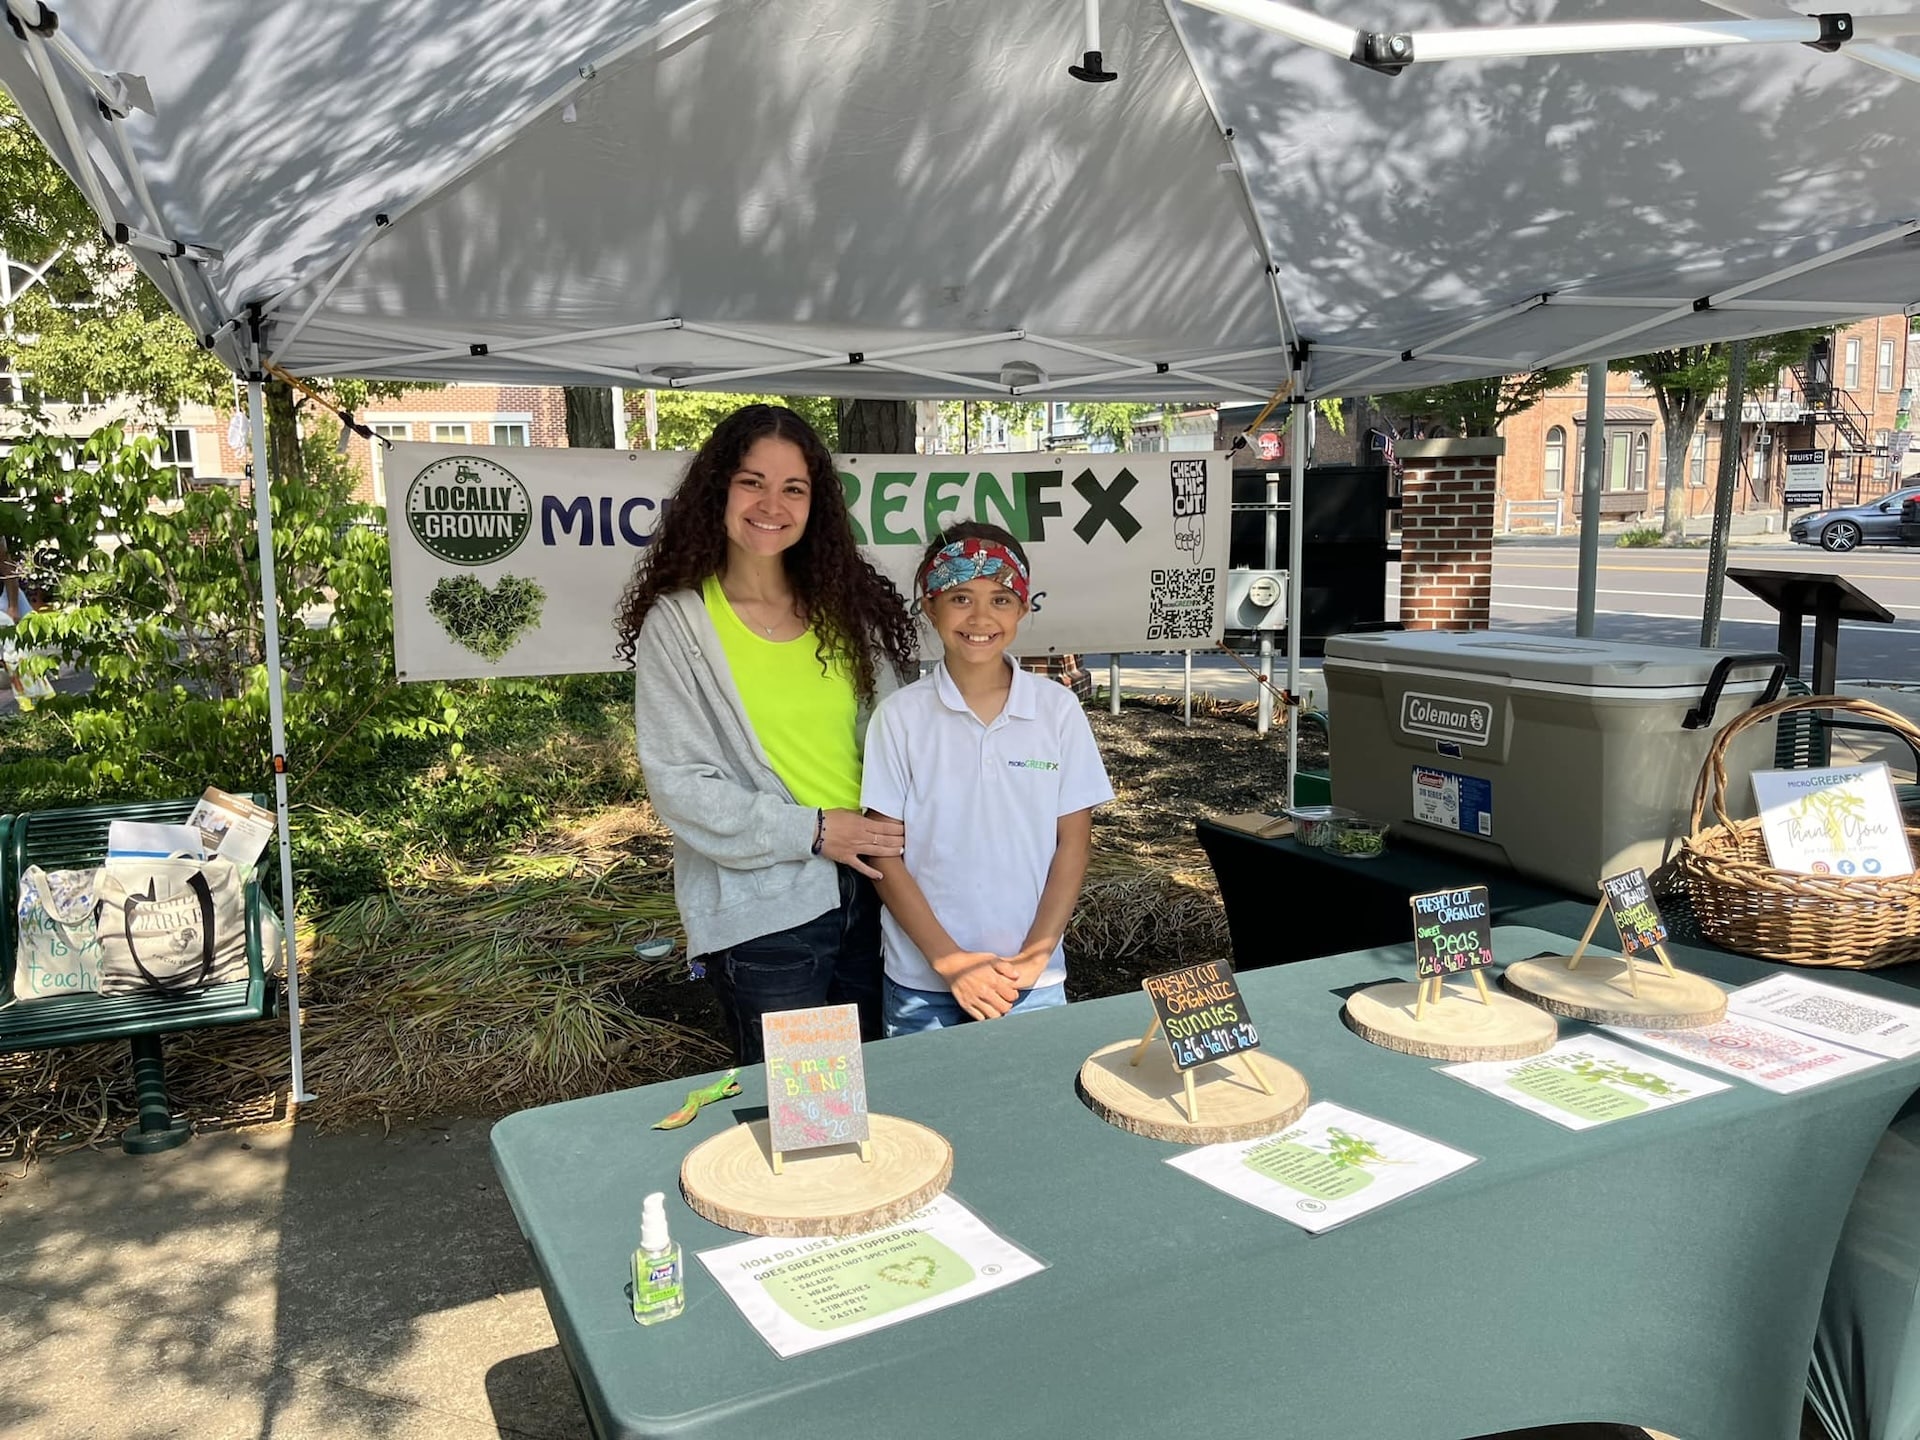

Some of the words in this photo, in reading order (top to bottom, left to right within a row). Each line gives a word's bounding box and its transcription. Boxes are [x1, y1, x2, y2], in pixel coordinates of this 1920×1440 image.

[1789, 453, 1814, 461] TRUIST
[1172, 461, 1204, 478] CHECK
[1175, 477, 1204, 496] THIS
[424, 486, 512, 512] LOCALLY
[1175, 495, 1205, 515] OUT!
[424, 514, 513, 539] GROWN
[1409, 699, 1468, 729] Coleman
[1777, 816, 1838, 848] Thank
[1842, 815, 1889, 846] You
[1415, 893, 1451, 914] FRESHLY
[1453, 890, 1472, 905] CUT
[50, 939, 68, 958] is
[1148, 969, 1199, 999] FRESHLY
[1196, 964, 1220, 984] CUT
[1166, 981, 1236, 1014] ORGANIC
[740, 1255, 773, 1271] HOW
[773, 1249, 796, 1261] DO
[803, 1238, 833, 1253] USE
[753, 1267, 787, 1282] GOES
[787, 1255, 826, 1272] GREAT
[826, 1250, 841, 1261] IN
[840, 1246, 858, 1257] OR
[856, 1232, 901, 1250] TOPPED
[792, 1264, 841, 1282] SMOOTHIES
[798, 1275, 835, 1290] SALADS
[807, 1283, 840, 1297] WRAPS
[813, 1284, 871, 1305] SANDWICHES
[820, 1295, 868, 1313] STIR-FRYS
[829, 1305, 867, 1320] PASTAS
